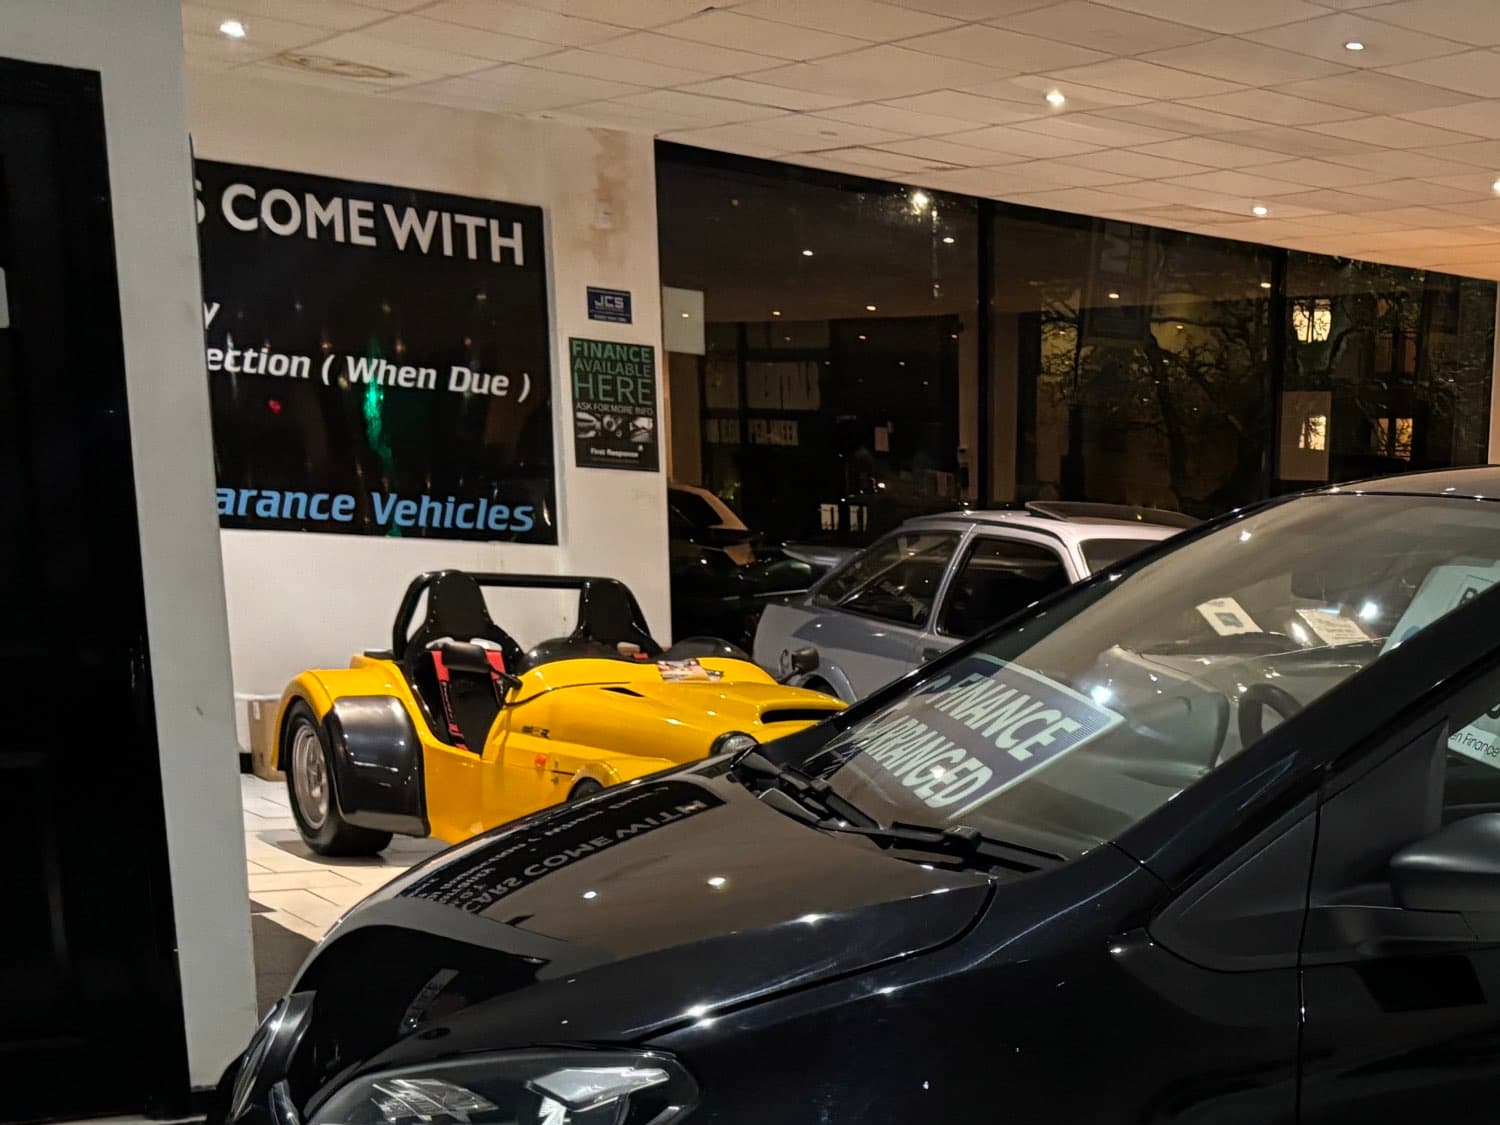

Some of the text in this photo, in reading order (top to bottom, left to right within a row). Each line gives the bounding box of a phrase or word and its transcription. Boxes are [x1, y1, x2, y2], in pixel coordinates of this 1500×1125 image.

[221, 183, 378, 247] COME
[382, 203, 525, 266] WITH
[594, 295, 624, 310] JCS
[571, 340, 651, 362] FINANCE
[207, 348, 531, 403] ection ( When Due )
[574, 359, 651, 377] AVAILABLE
[575, 374, 653, 405] HERE
[576, 402, 593, 411] ASK
[594, 403, 610, 412] FOR
[611, 405, 633, 415] MORE
[215, 487, 535, 532] arance Vehicles
[925, 672, 1082, 762] FINANCE
[1463, 733, 1500, 758] Finance
[860, 714, 993, 809] ARRANGED
